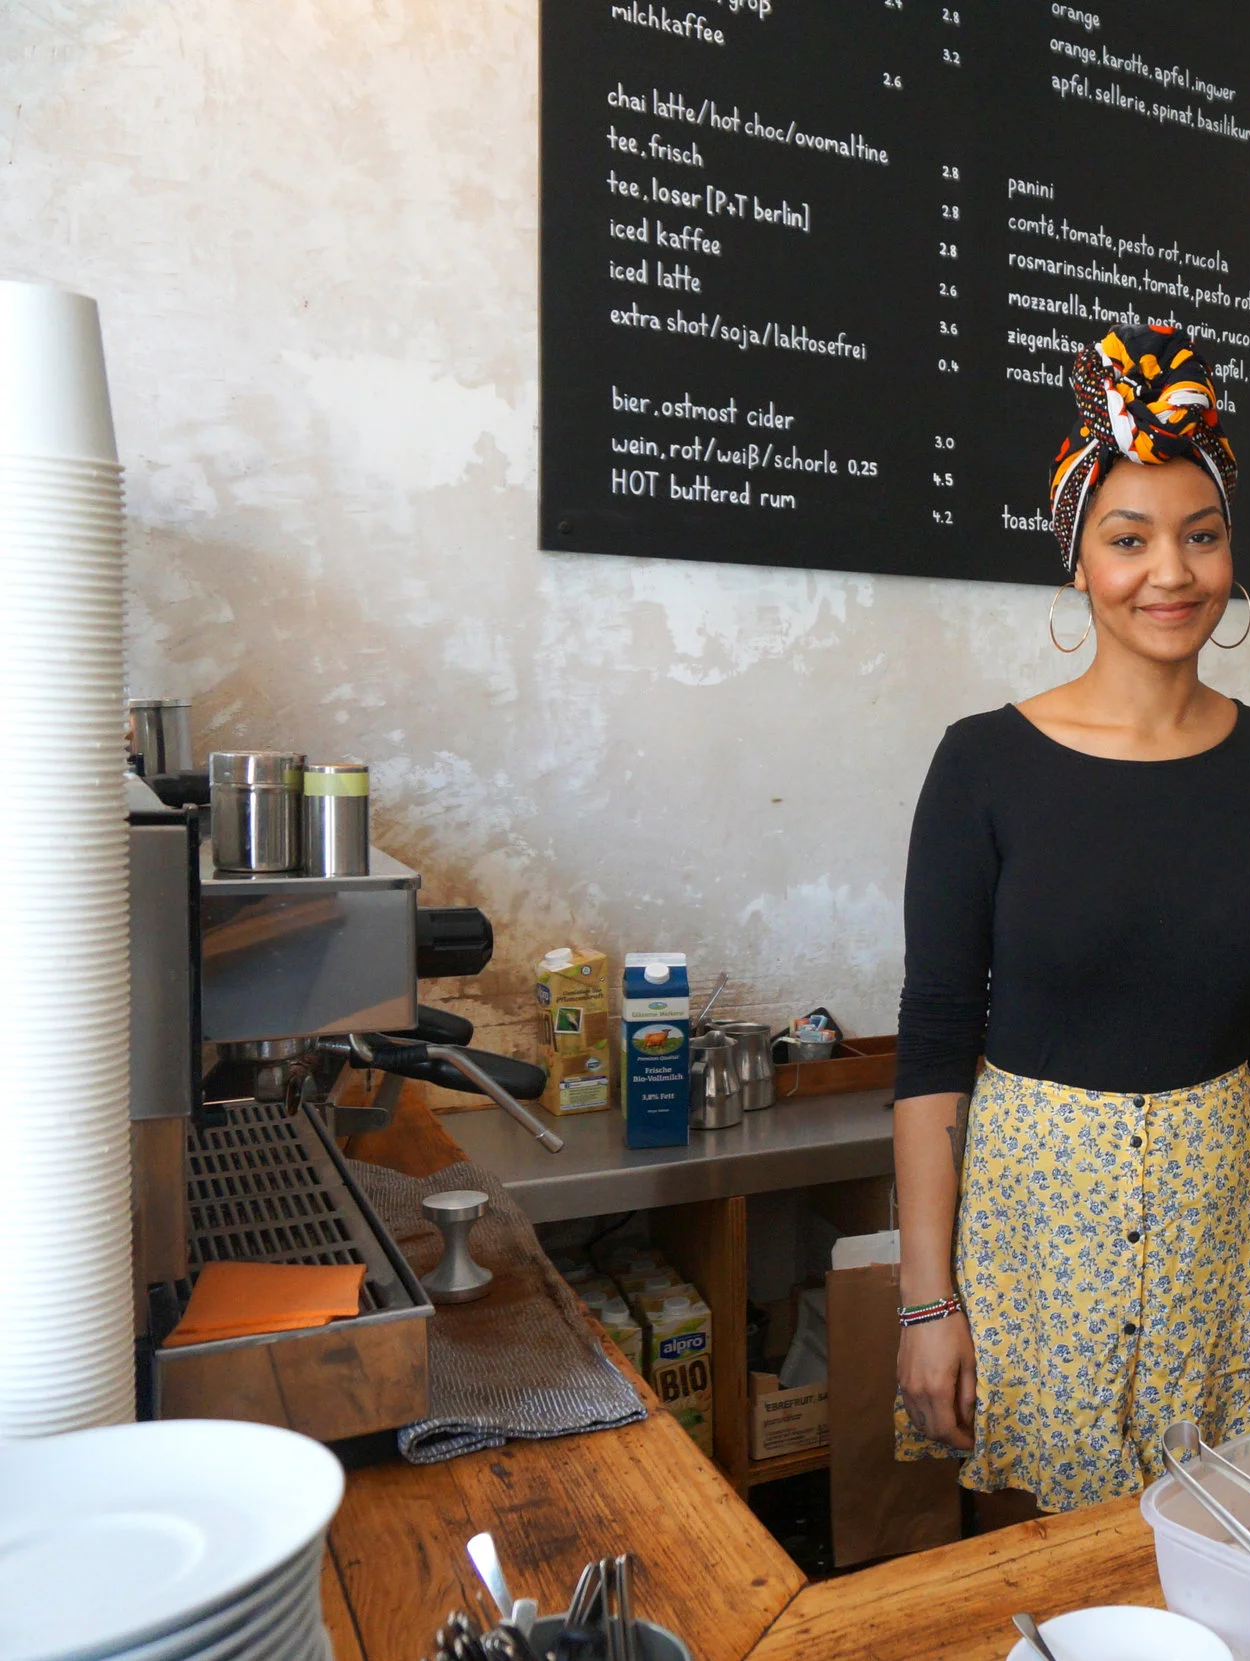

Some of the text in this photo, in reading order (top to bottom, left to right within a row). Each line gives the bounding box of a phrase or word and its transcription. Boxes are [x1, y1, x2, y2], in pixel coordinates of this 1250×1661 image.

[611, 1, 725, 44] milchkaffee
[942, 8, 959, 24] 2.8
[1051, 2, 1101, 31] orange
[942, 48, 960, 64] 3.2
[883, 72, 902, 88] 2.6
[608, 82, 647, 113] chai
[649, 133, 703, 167] frisch
[942, 165, 959, 181] 2.8
[1008, 177, 1055, 200] panini
[651, 177, 702, 208] loser
[753, 196, 812, 233] berlin]
[942, 205, 959, 221] 2.8
[609, 217, 722, 257] iced kaffee
[939, 243, 957, 259] 2.8
[1118, 234, 1154, 258] pesto
[1185, 250, 1229, 273] rucola
[609, 260, 702, 292] iced latte
[939, 282, 957, 297] 2.6
[1195, 284, 1231, 308] pesto
[610, 302, 662, 330] extra
[939, 320, 959, 336] 3.6
[937, 358, 960, 373] 0.4
[1006, 362, 1064, 387] roasted
[660, 392, 738, 424] ostmost
[746, 402, 795, 430] cider
[934, 436, 955, 450] 3.0
[611, 468, 796, 509] HOT buttered rum
[932, 472, 954, 488] 4.5
[932, 510, 954, 526] 4.2
[633, 1074, 684, 1083] Bio-Vollmilch
[645, 1067, 672, 1075] Frische
[663, 1337, 702, 1354] alpro
[659, 1360, 708, 1403] BIO
